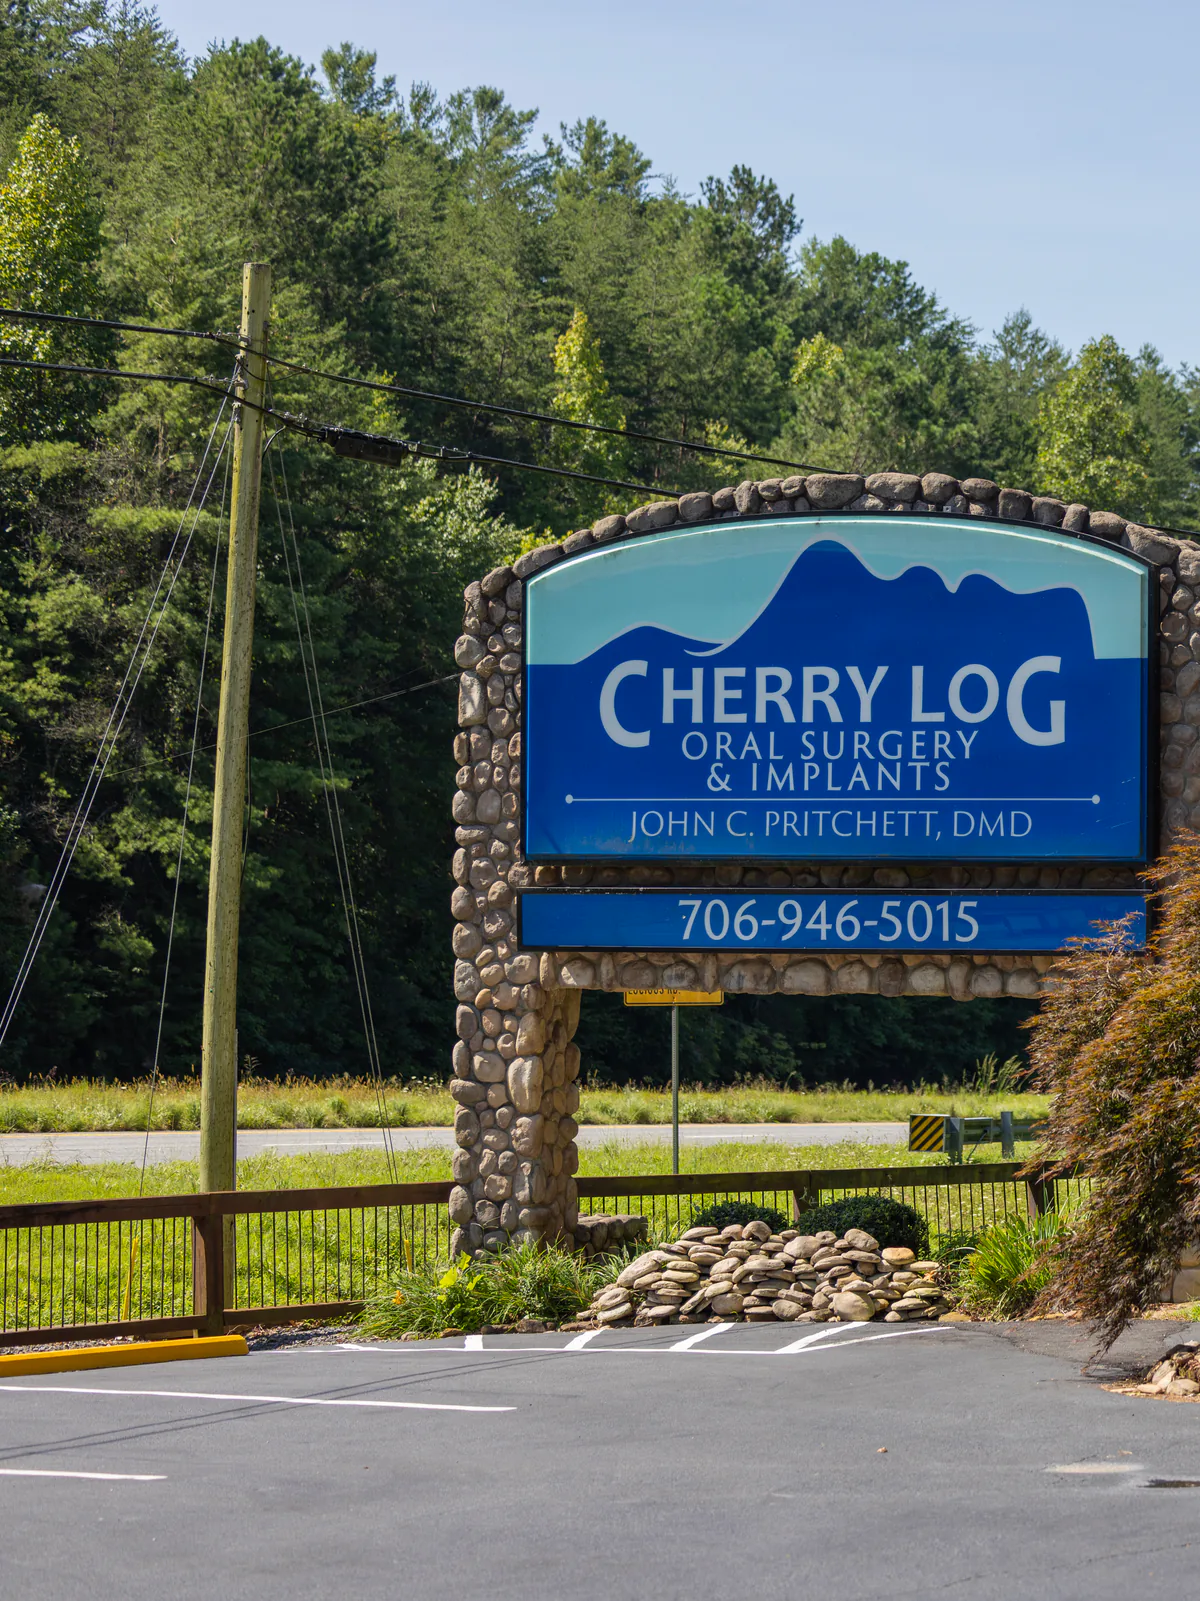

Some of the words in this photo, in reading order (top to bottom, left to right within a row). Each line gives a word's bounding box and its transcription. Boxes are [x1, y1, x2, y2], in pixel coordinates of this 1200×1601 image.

[600, 659, 888, 748] CHERRY
[911, 655, 1066, 747] LOG
[682, 732, 784, 760] ORAL
[800, 730, 979, 761] SURGERY
[706, 763, 732, 792] &
[752, 762, 950, 791] IMPLANTS
[628, 811, 715, 842] JOHN
[726, 811, 754, 837] C.
[765, 811, 941, 841] PRITCHETT,
[953, 811, 1032, 837] DMD
[678, 900, 979, 942] 706-946-5015
